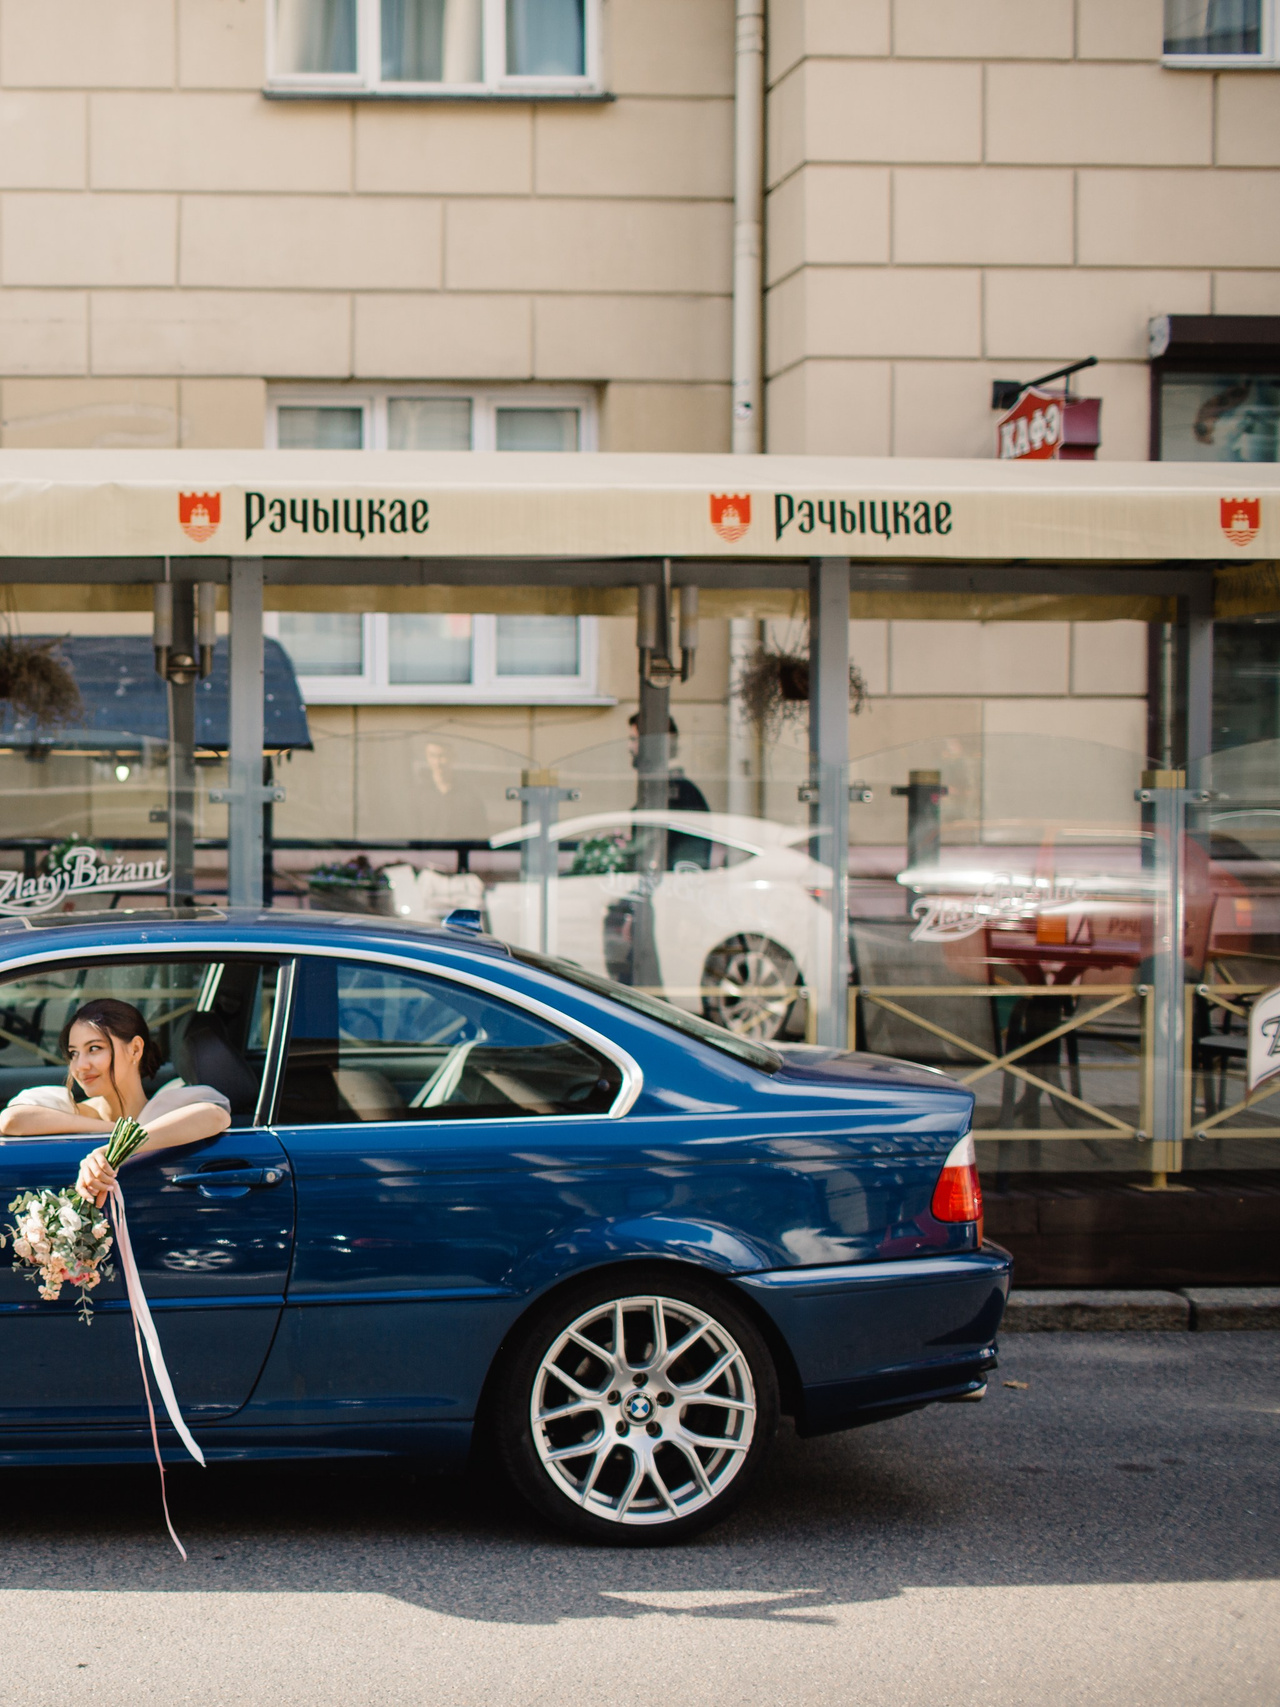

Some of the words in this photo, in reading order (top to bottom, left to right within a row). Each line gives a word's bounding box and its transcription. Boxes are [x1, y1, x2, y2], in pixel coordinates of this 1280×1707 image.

[1000, 403, 1061, 459] КАФЭ
[244, 490, 430, 542] Рэчыцкае
[774, 493, 953, 543] Рэчыцкае
[63, 846, 172, 896] Bažant
